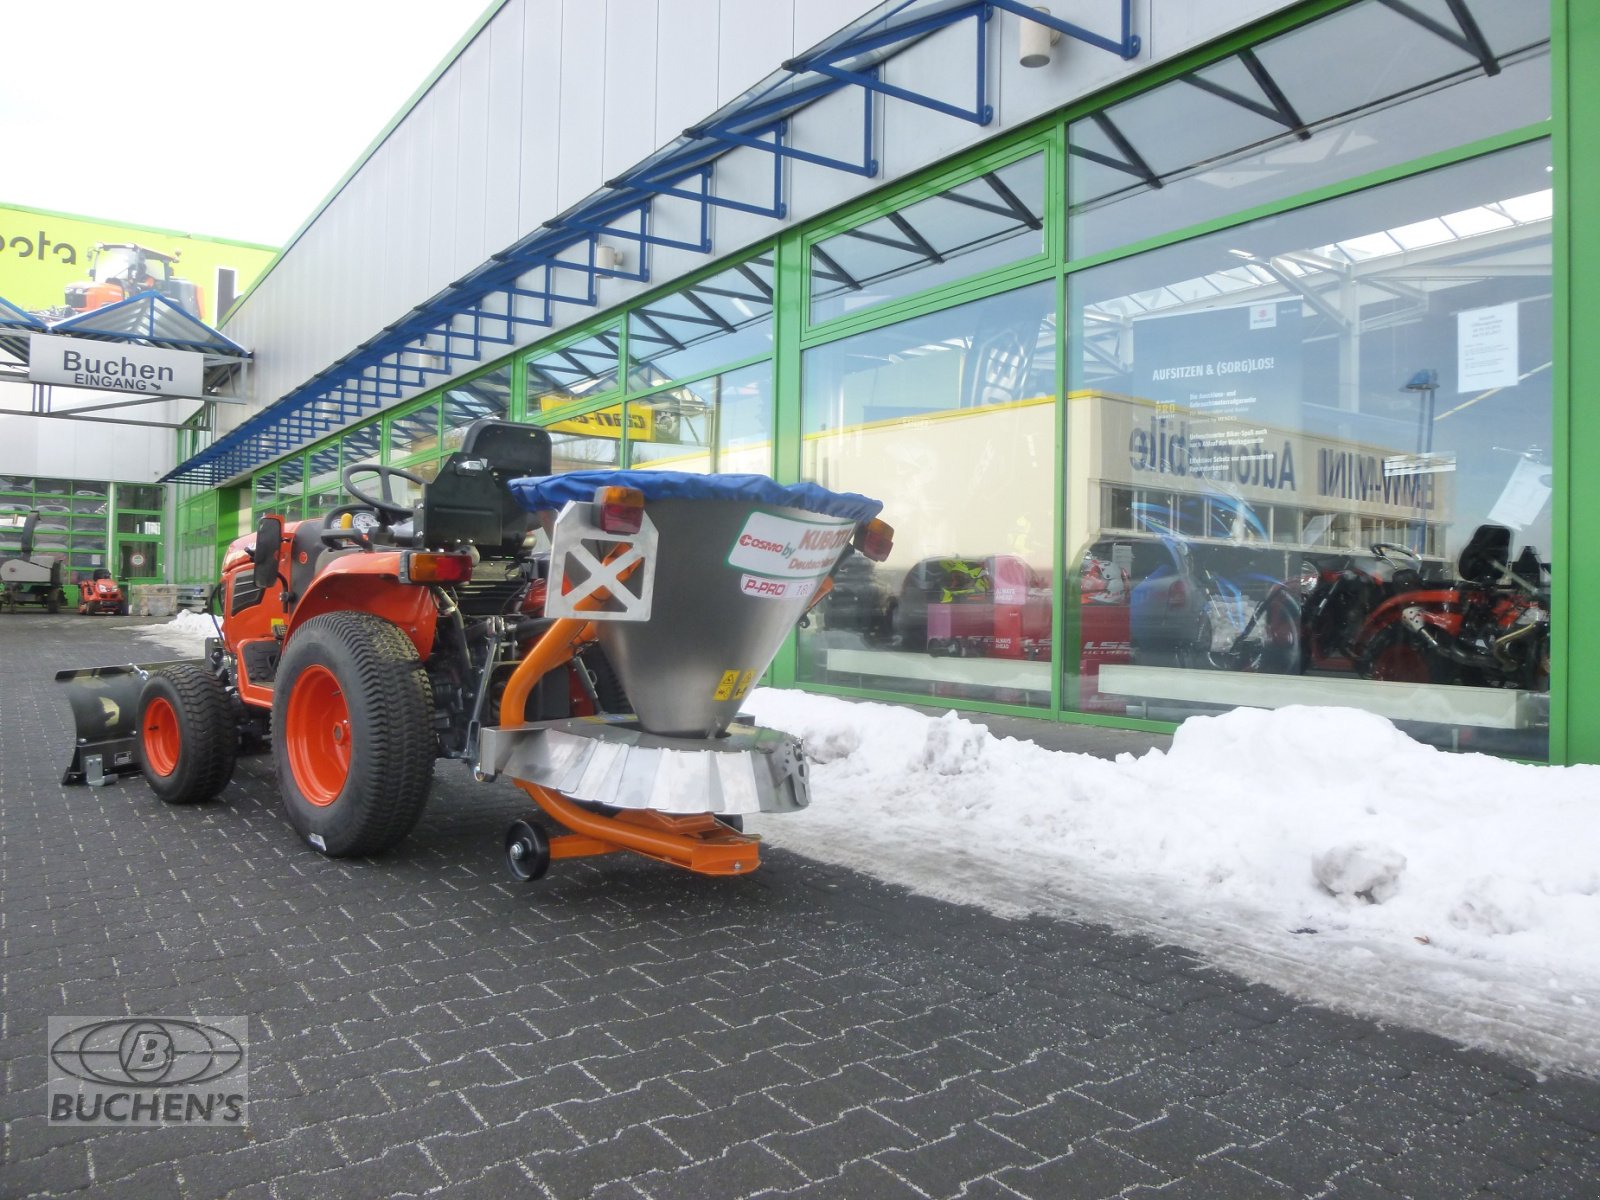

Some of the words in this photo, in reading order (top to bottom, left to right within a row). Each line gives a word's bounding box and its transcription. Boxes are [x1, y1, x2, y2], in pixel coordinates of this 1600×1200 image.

[0, 231, 76, 265] ota
[63, 350, 174, 382] Buchen
[1152, 364, 1204, 381] AUFSITZEN
[1206, 364, 1214, 376] &
[1216, 357, 1275, 376] (SORG)LOS!
[74, 373, 147, 391] EINGANG
[780, 542, 796, 559] by
[744, 579, 786, 596] P-PRO
